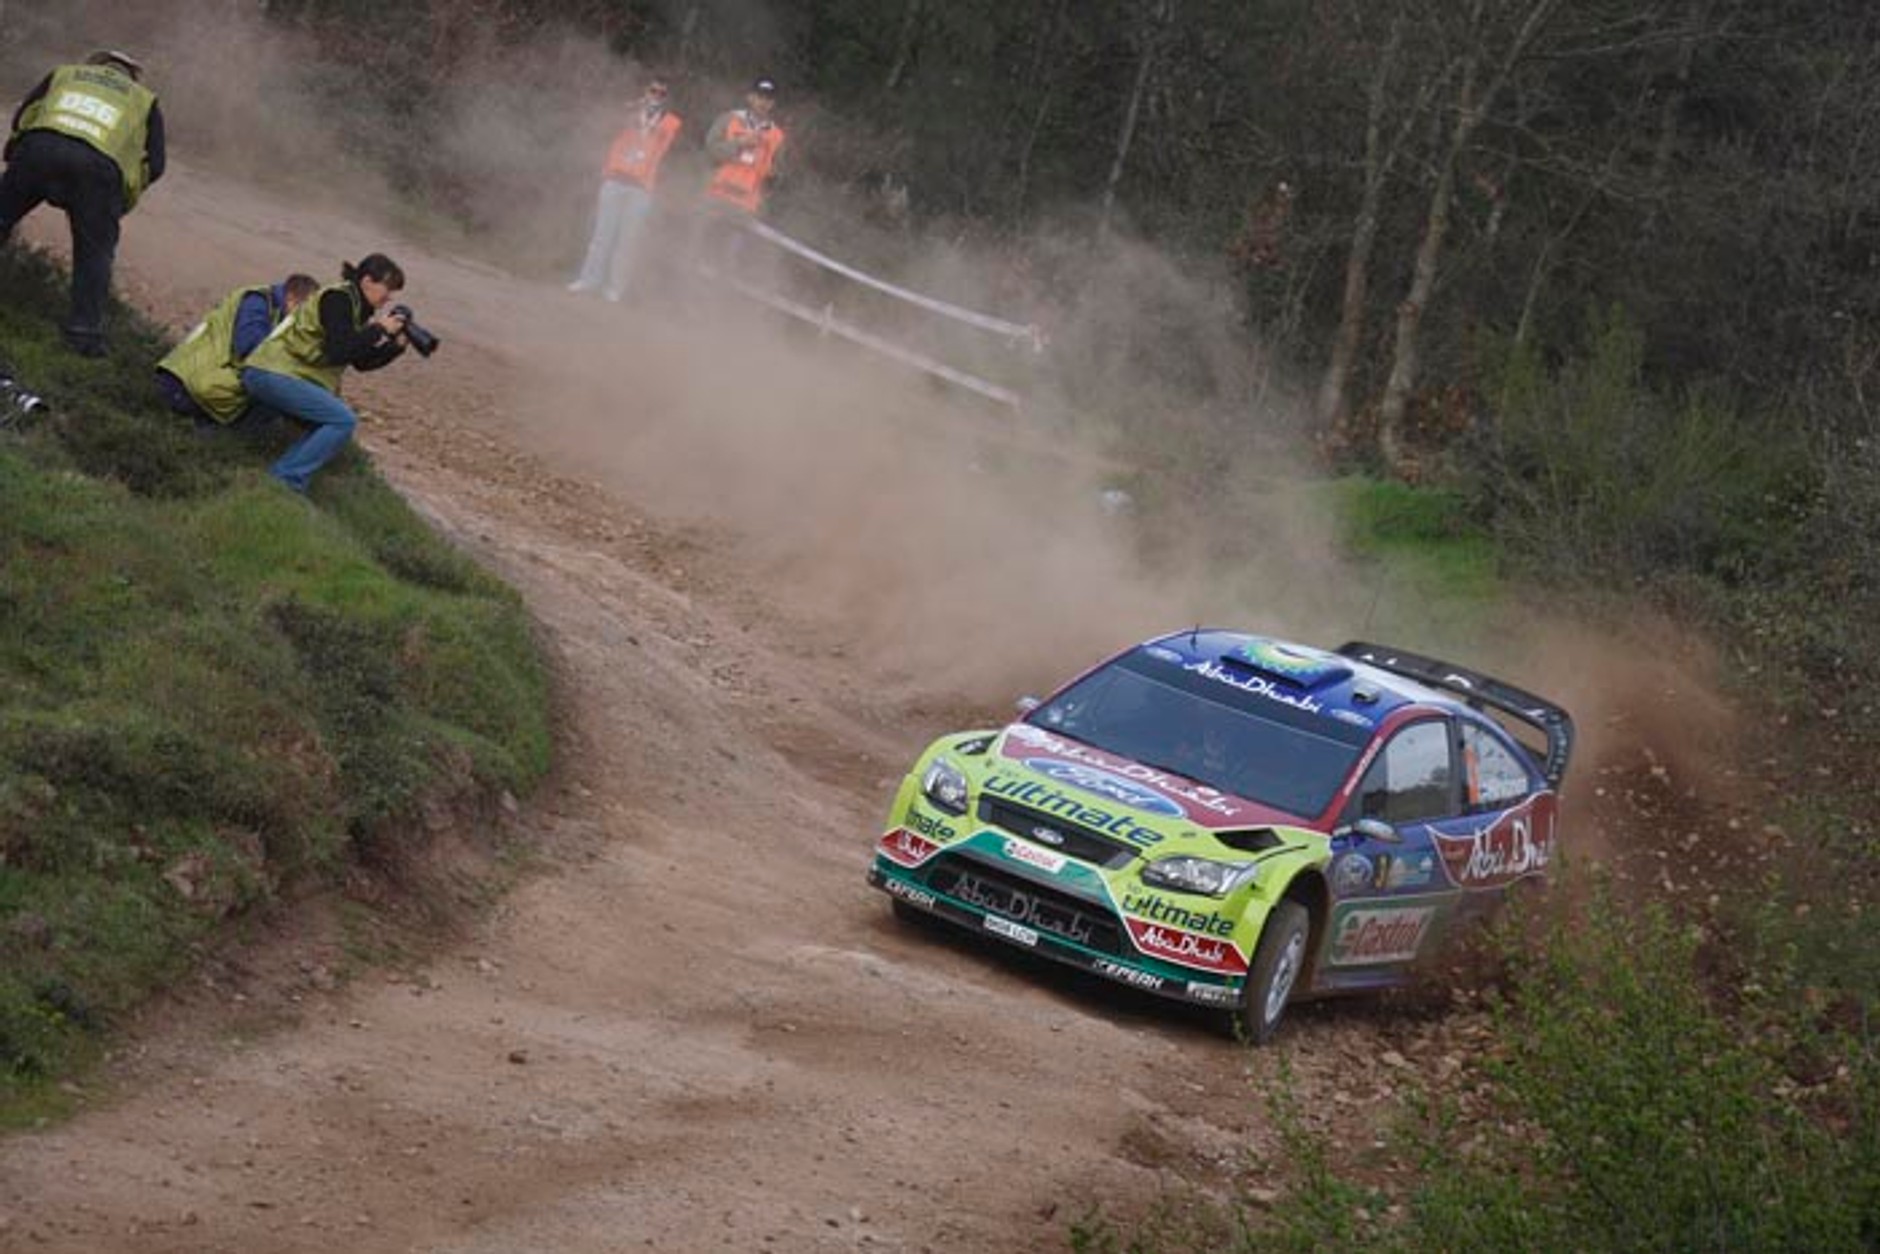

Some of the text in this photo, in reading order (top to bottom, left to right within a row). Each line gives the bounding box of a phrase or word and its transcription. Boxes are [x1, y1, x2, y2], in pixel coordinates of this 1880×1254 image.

[1183, 660, 1323, 713] Abu Dhabi
[983, 775, 1165, 845] ultimate
[1122, 894, 1234, 936] ultimate
